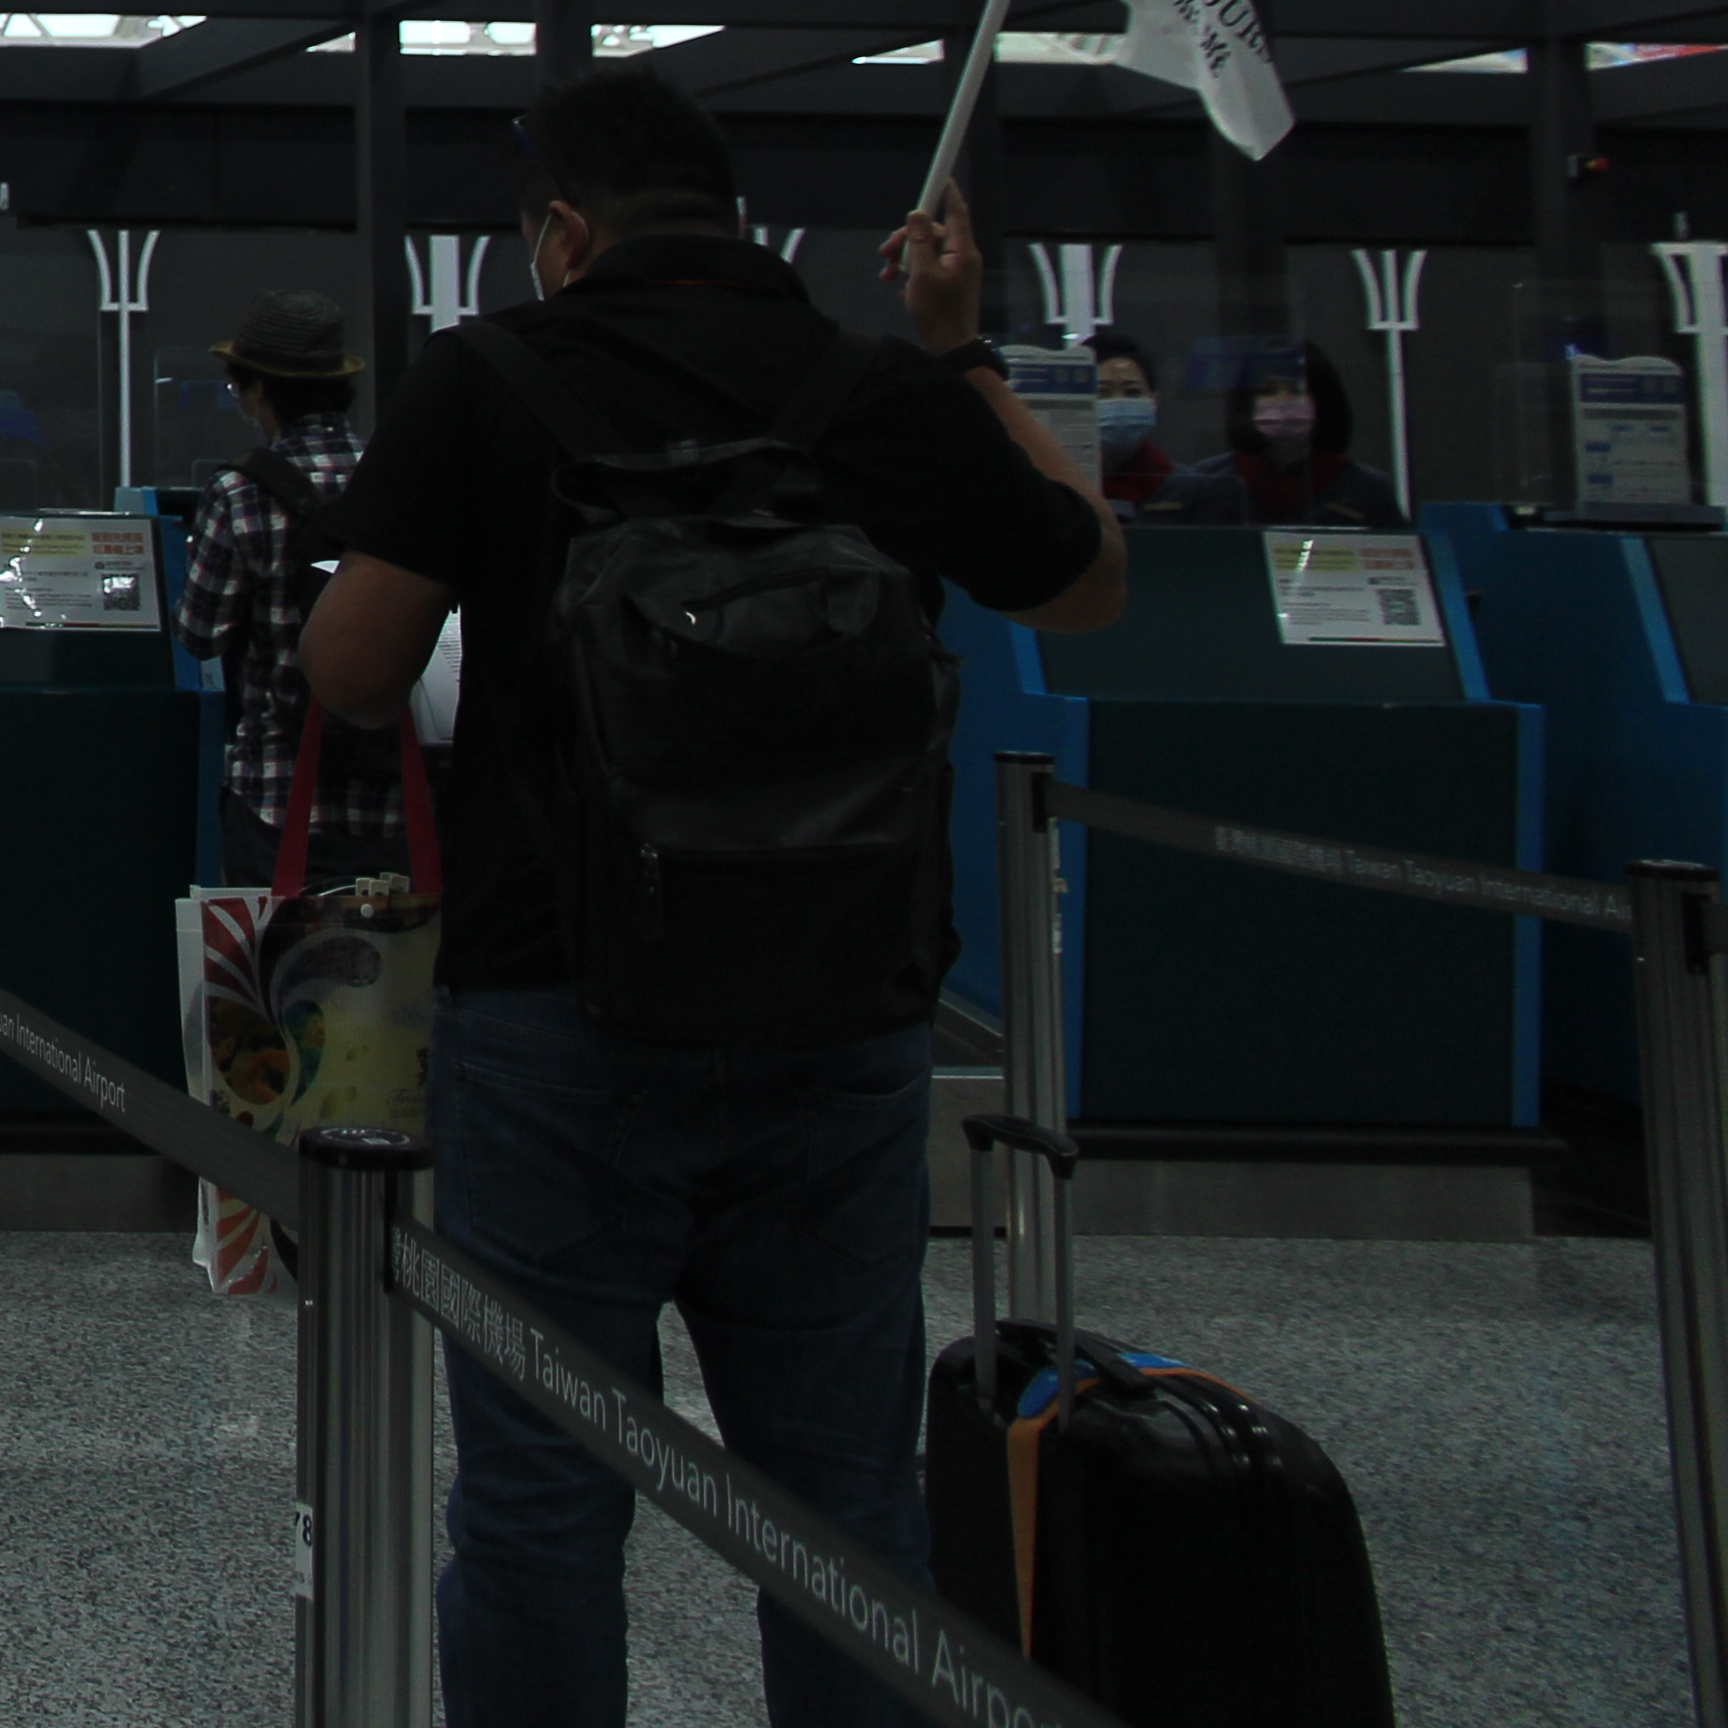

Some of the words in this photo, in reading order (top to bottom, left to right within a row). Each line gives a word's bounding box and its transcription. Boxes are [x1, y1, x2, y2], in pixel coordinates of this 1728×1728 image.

[15, 1013, 82, 1085] International
[82, 1056, 126, 1113] Airport
[529, 1326, 607, 1432] Taiwan
[611, 1385, 718, 1518] Taoyuan
[726, 1473, 921, 1676] International
